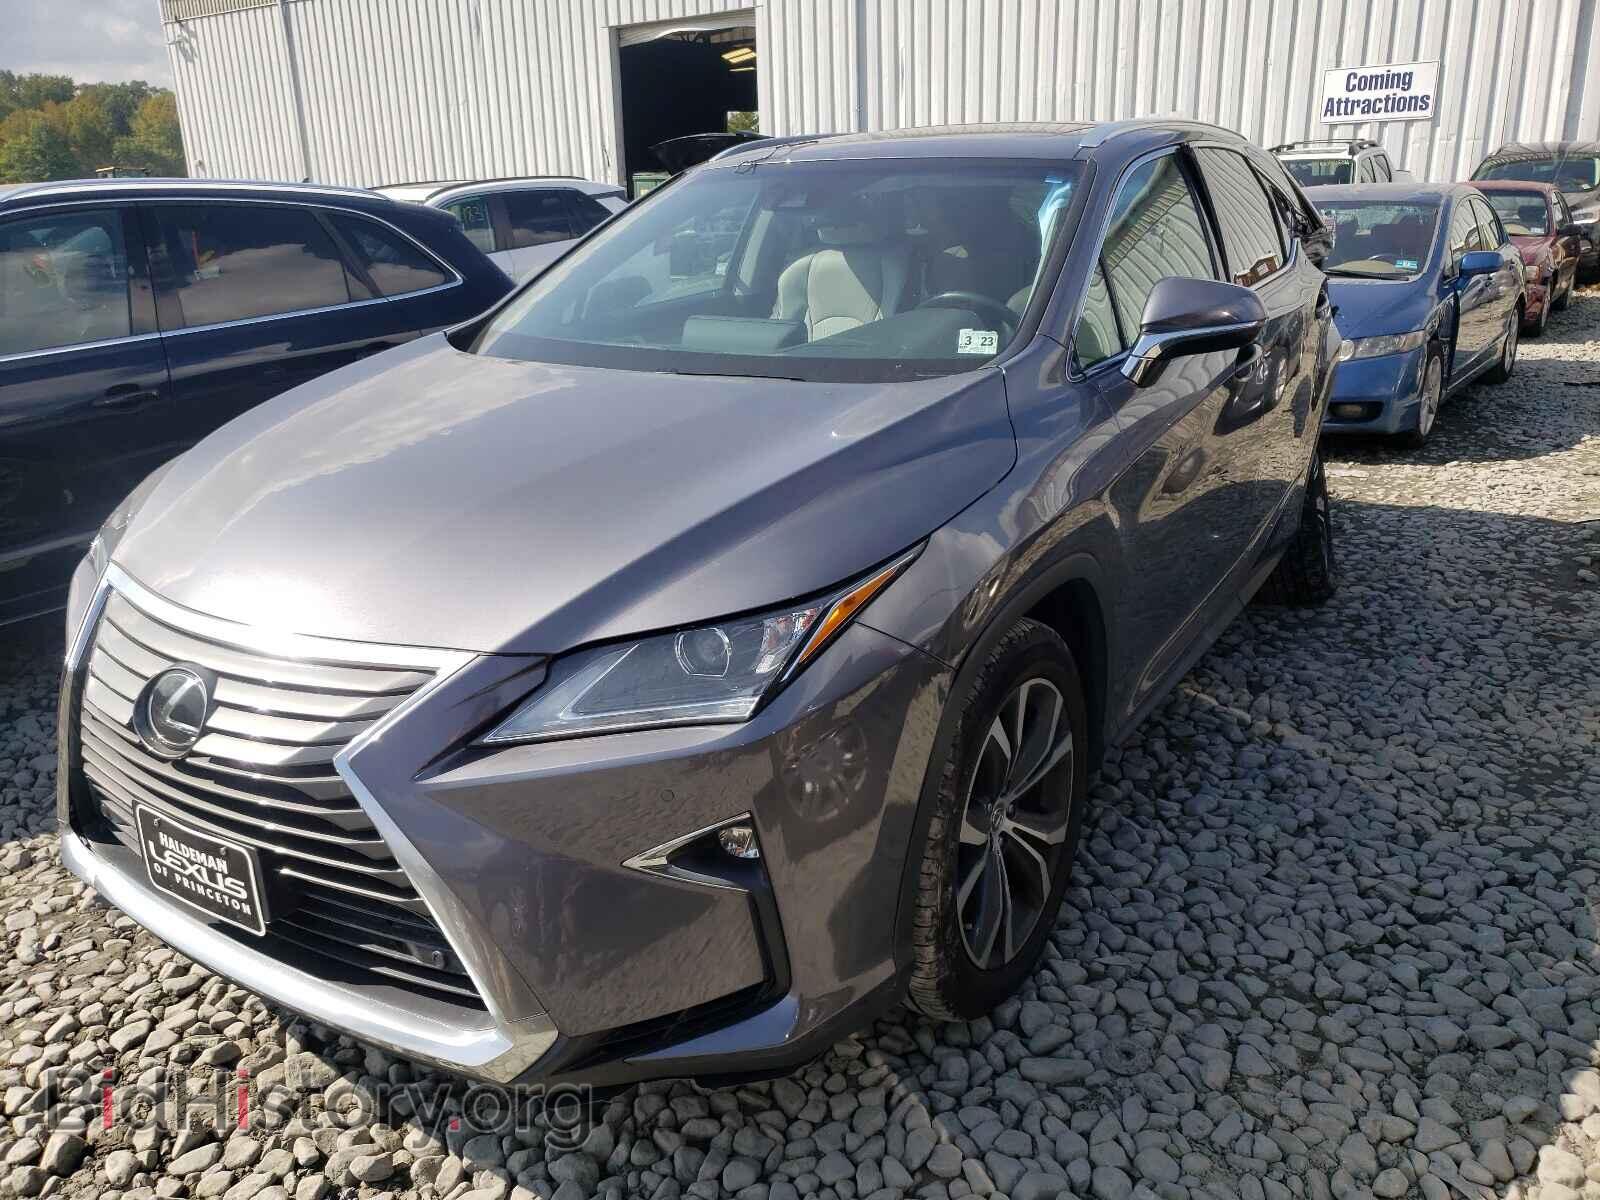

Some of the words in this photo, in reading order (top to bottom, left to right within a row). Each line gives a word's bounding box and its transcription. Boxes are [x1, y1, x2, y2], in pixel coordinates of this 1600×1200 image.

[1345, 69, 1414, 93] Coming
[1323, 93, 1431, 118] Attractions
[964, 335, 972, 346] 3
[980, 336, 994, 347] 23
[148, 840, 248, 900] LEXUS
[158, 831, 229, 875] HALDEMAN
[153, 862, 169, 878] OF
[174, 872, 252, 916] PRINCETON
